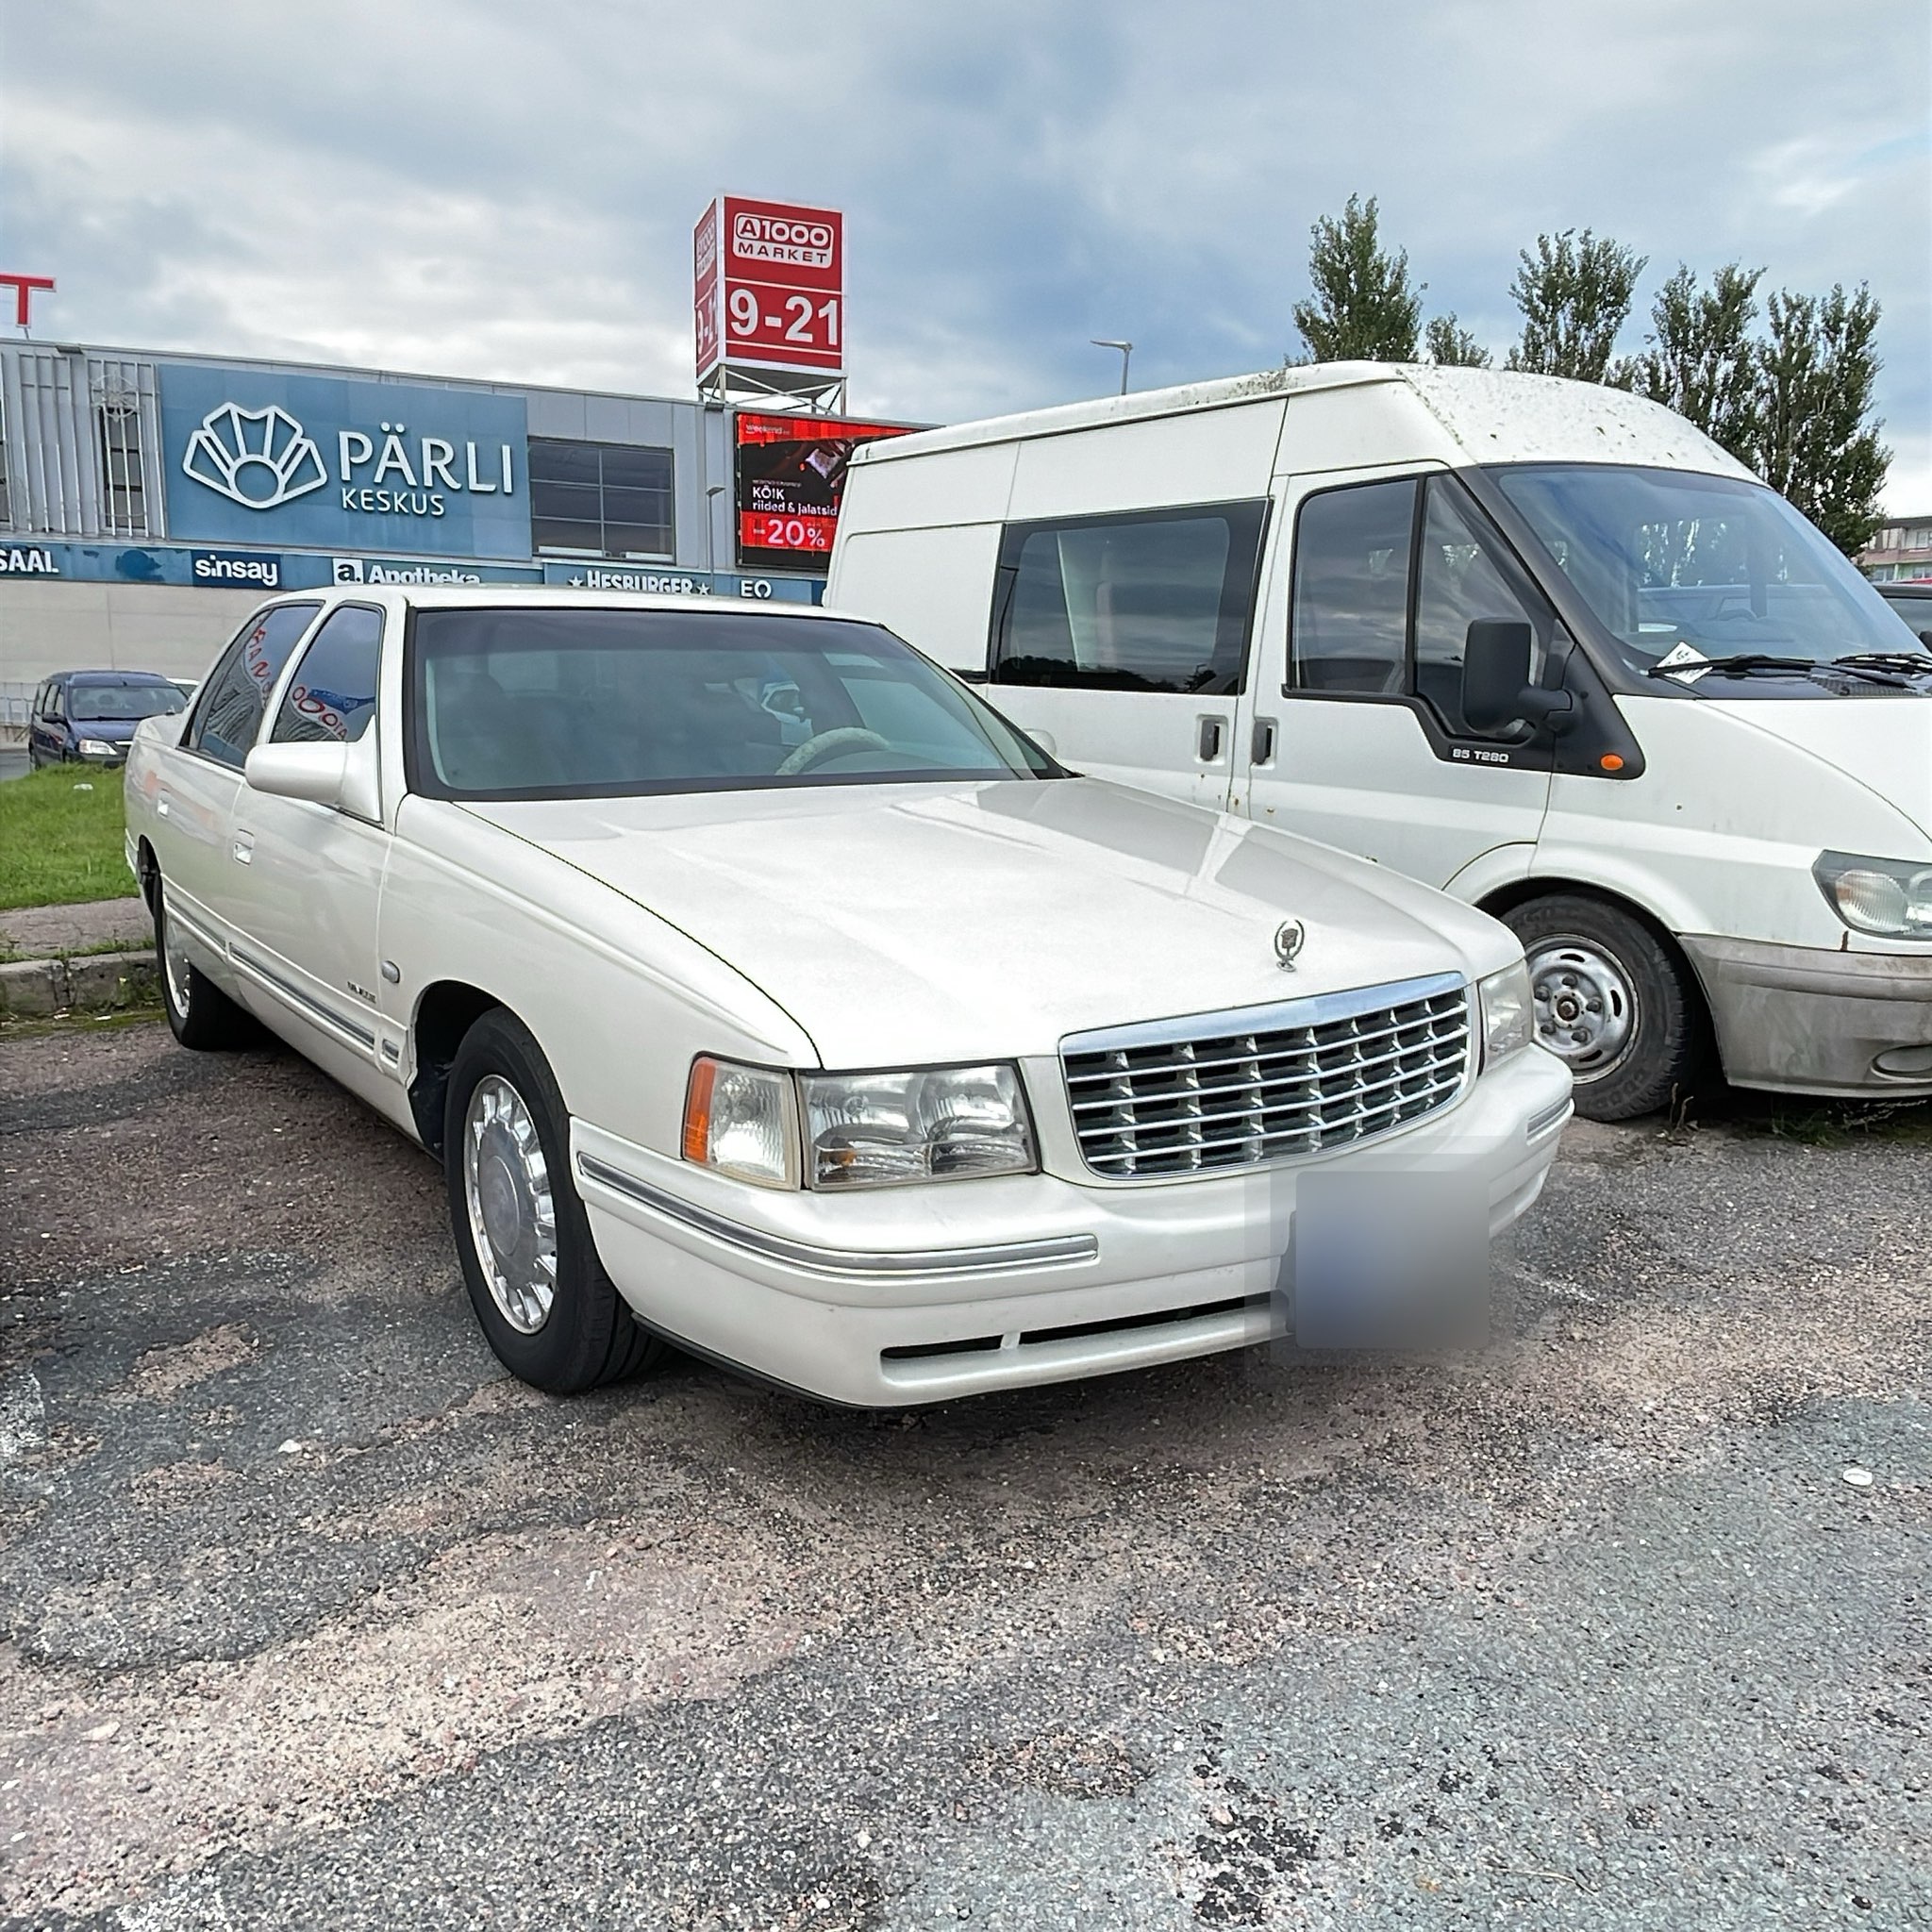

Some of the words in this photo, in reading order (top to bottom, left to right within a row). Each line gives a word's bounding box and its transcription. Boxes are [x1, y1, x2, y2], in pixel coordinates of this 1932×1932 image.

[738, 217, 829, 247] A1000
[738, 242, 827, 264] MARKET
[0, 273, 56, 327] T
[729, 288, 838, 346] 9-21
[339, 422, 512, 493] PÄRLI
[341, 488, 445, 516] KESKUS
[753, 485, 784, 501] KÕIK
[753, 500, 786, 512] riided
[788, 502, 795, 513] &
[798, 503, 838, 516] jalatsid
[195, 554, 277, 587] sinsay
[587, 570, 692, 594] HESBURGER
[1474, 751, 1509, 763] T280
